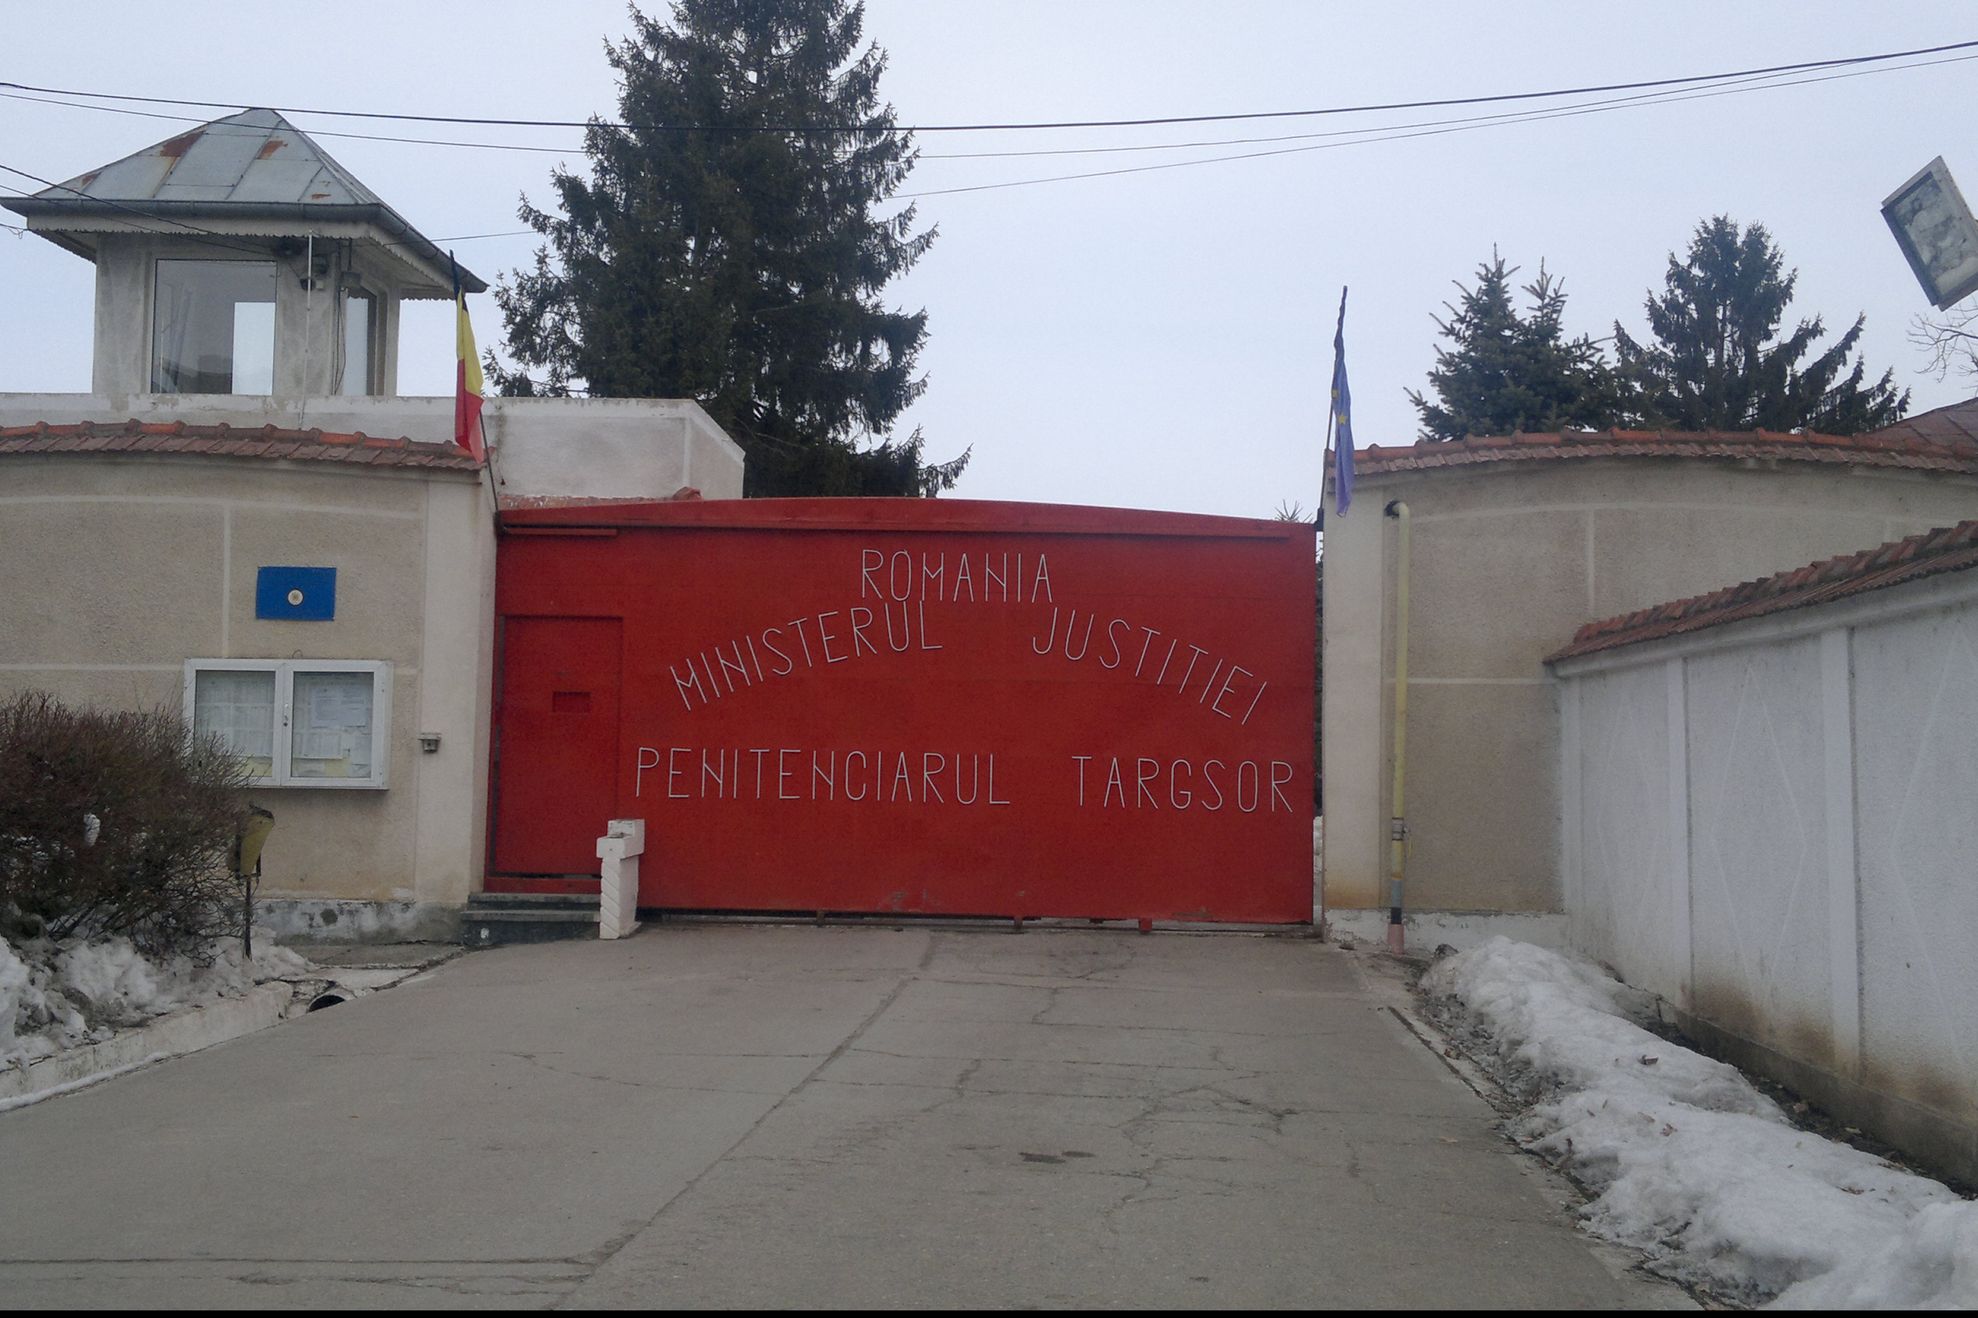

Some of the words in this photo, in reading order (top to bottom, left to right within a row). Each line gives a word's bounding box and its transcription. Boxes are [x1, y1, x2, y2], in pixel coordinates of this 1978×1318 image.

[862, 549, 1053, 603] ROMANIA
[669, 600, 943, 711] MINISTERUL
[1032, 607, 1267, 725] JUSTITIEI
[635, 746, 1011, 805] PENITENCIARUL
[1071, 755, 1293, 813] TARGSOR
